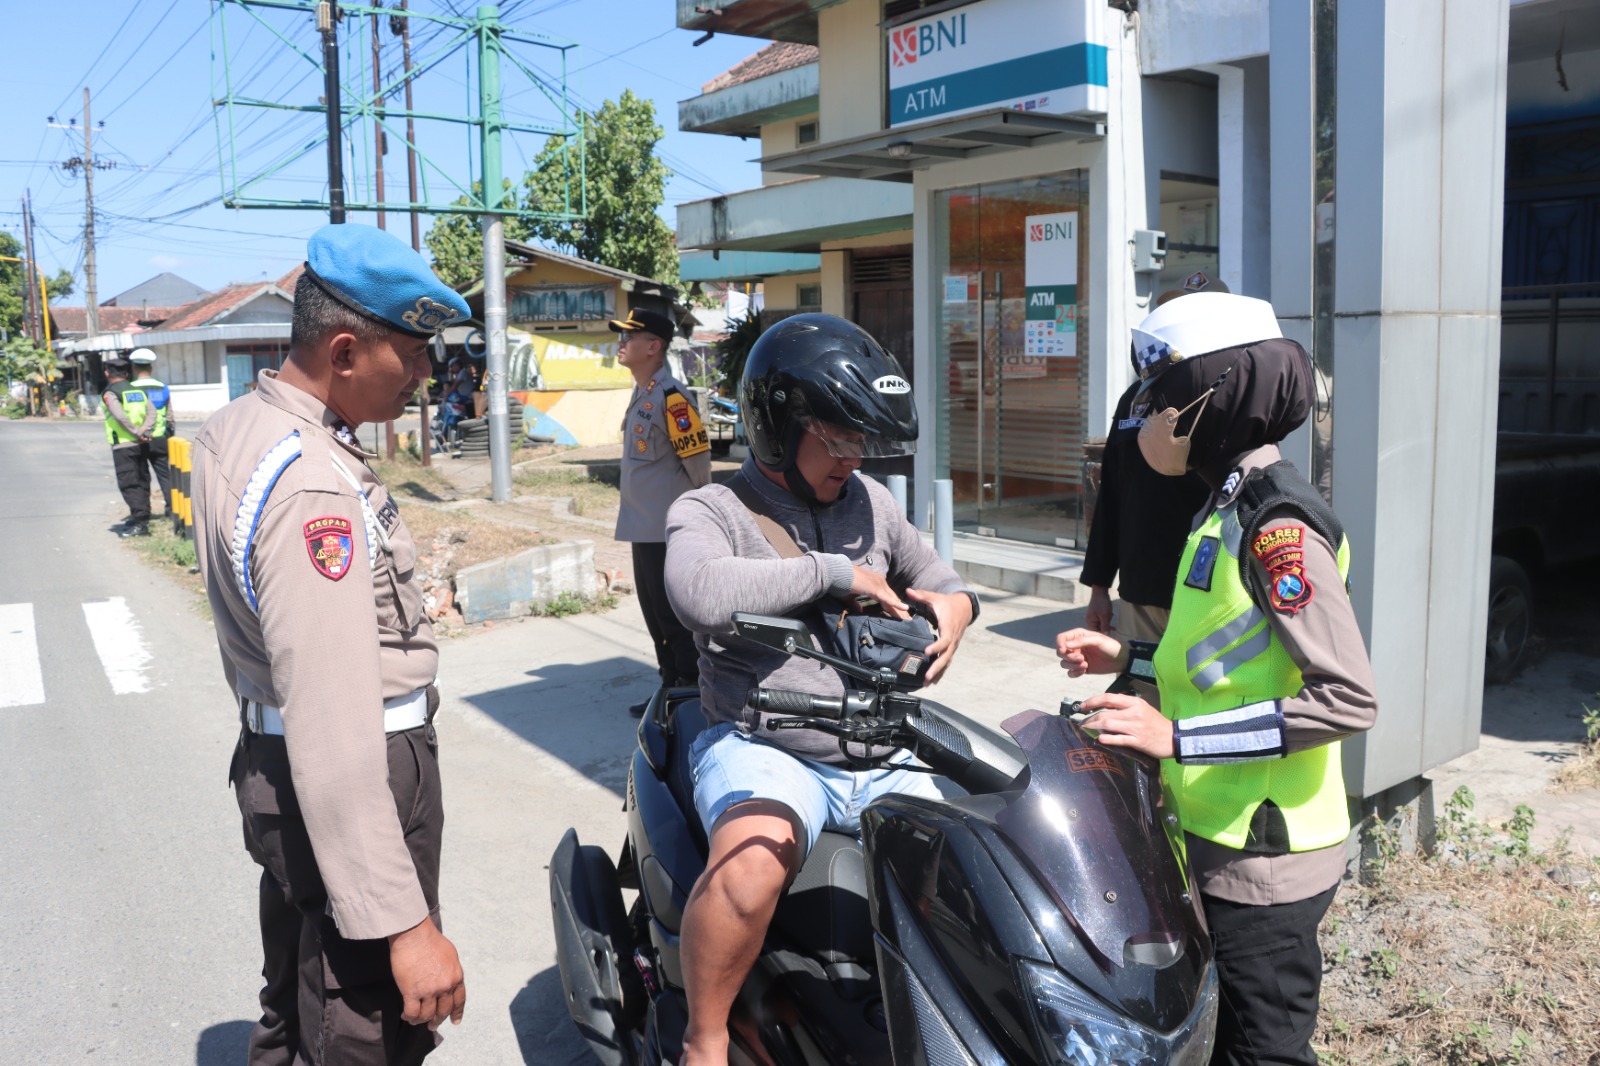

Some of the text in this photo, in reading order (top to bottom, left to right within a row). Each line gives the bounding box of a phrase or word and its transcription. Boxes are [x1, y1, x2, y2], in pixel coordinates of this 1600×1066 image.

[919, 13, 967, 56] BNI
[904, 85, 946, 114] ATM
[1044, 221, 1073, 241] BNI
[1030, 292, 1055, 306] ATM
[1056, 304, 1075, 323] 24
[544, 343, 619, 360] MAXXI
[879, 380, 905, 389] INK
[309, 519, 348, 531] PROPAM
[1254, 528, 1300, 553] POLRES
